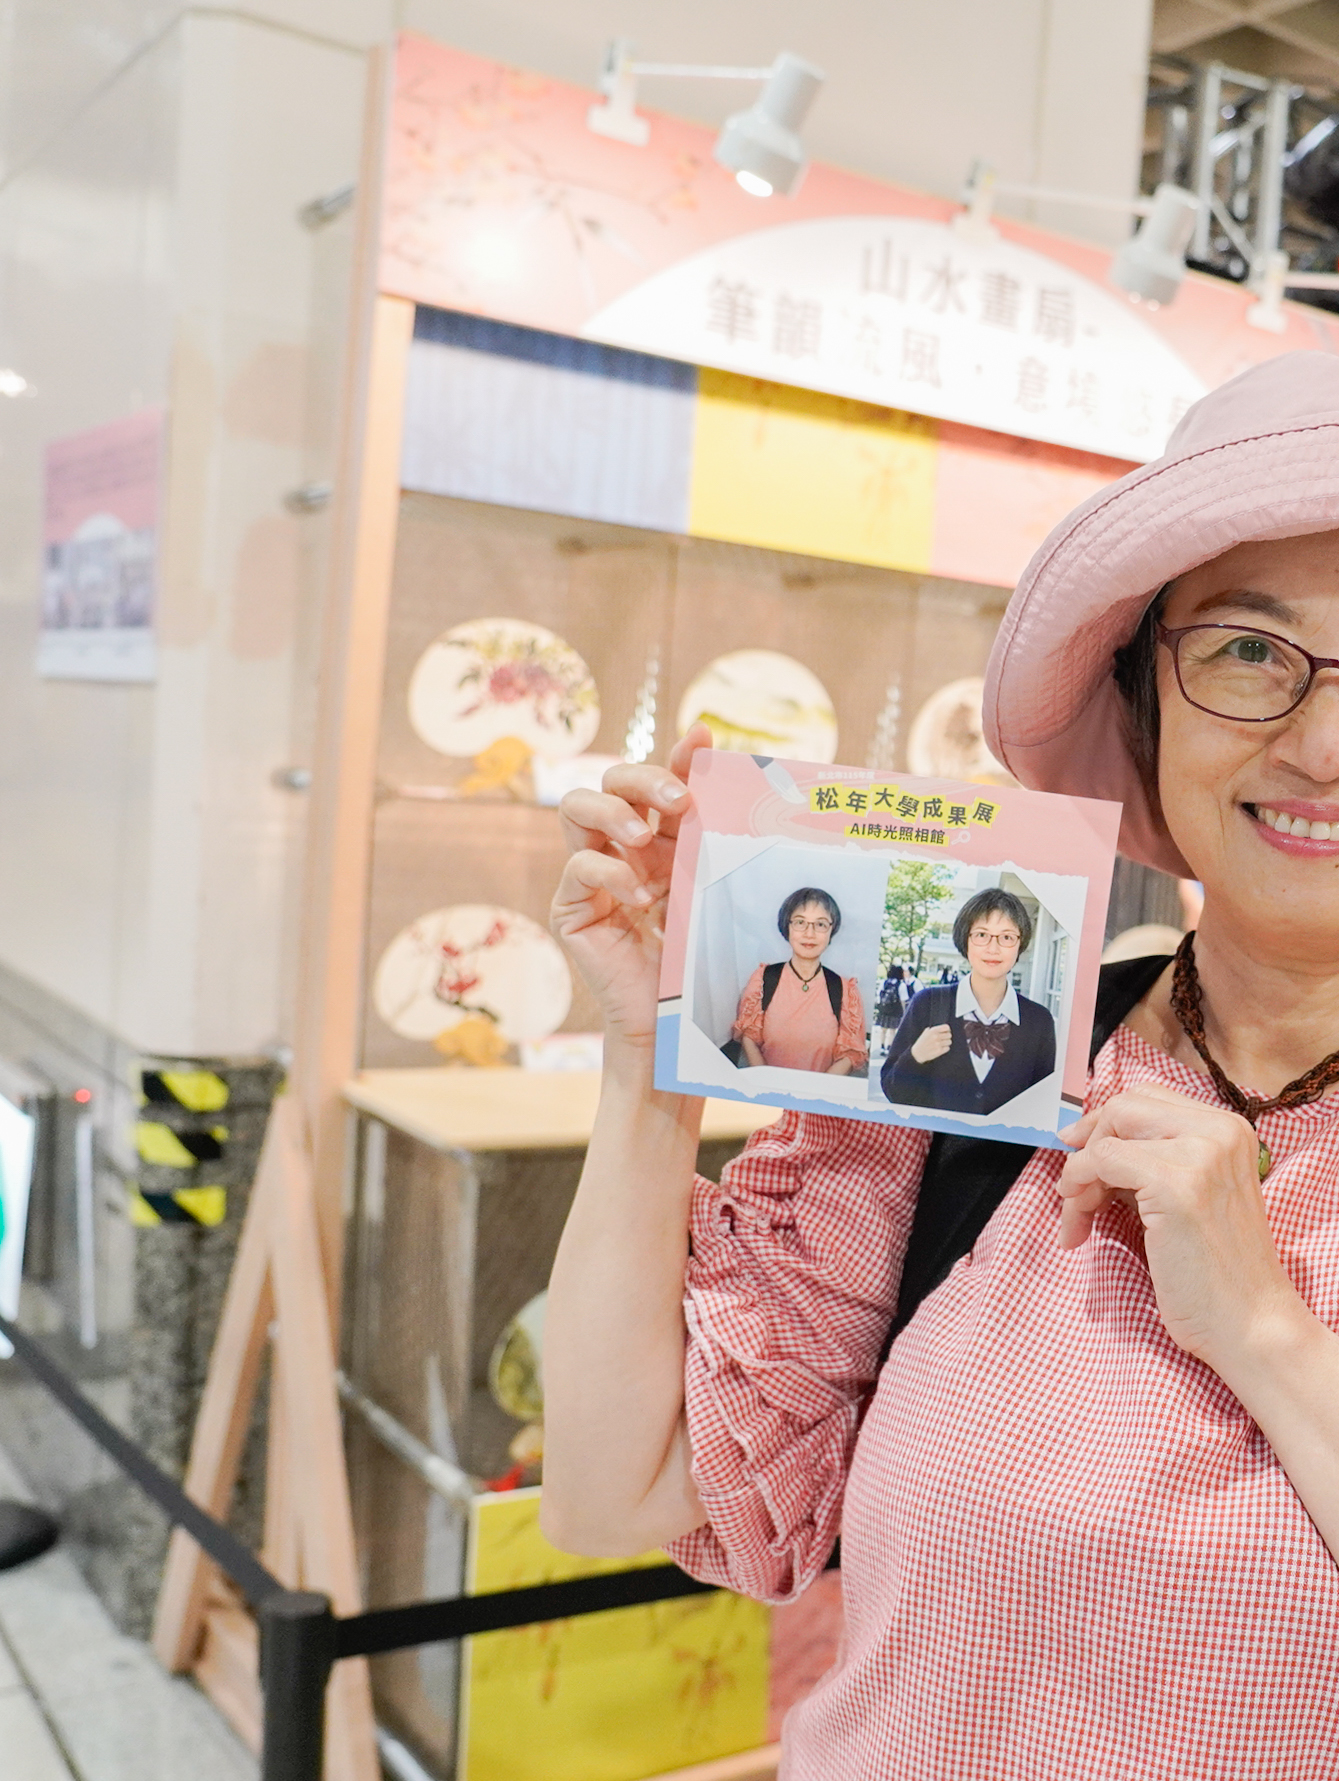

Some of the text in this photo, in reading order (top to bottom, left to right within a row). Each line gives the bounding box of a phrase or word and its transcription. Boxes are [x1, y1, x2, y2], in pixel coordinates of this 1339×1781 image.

[816, 787, 995, 826] 松年大學成果展
[850, 823, 945, 844] AI時光照相館
